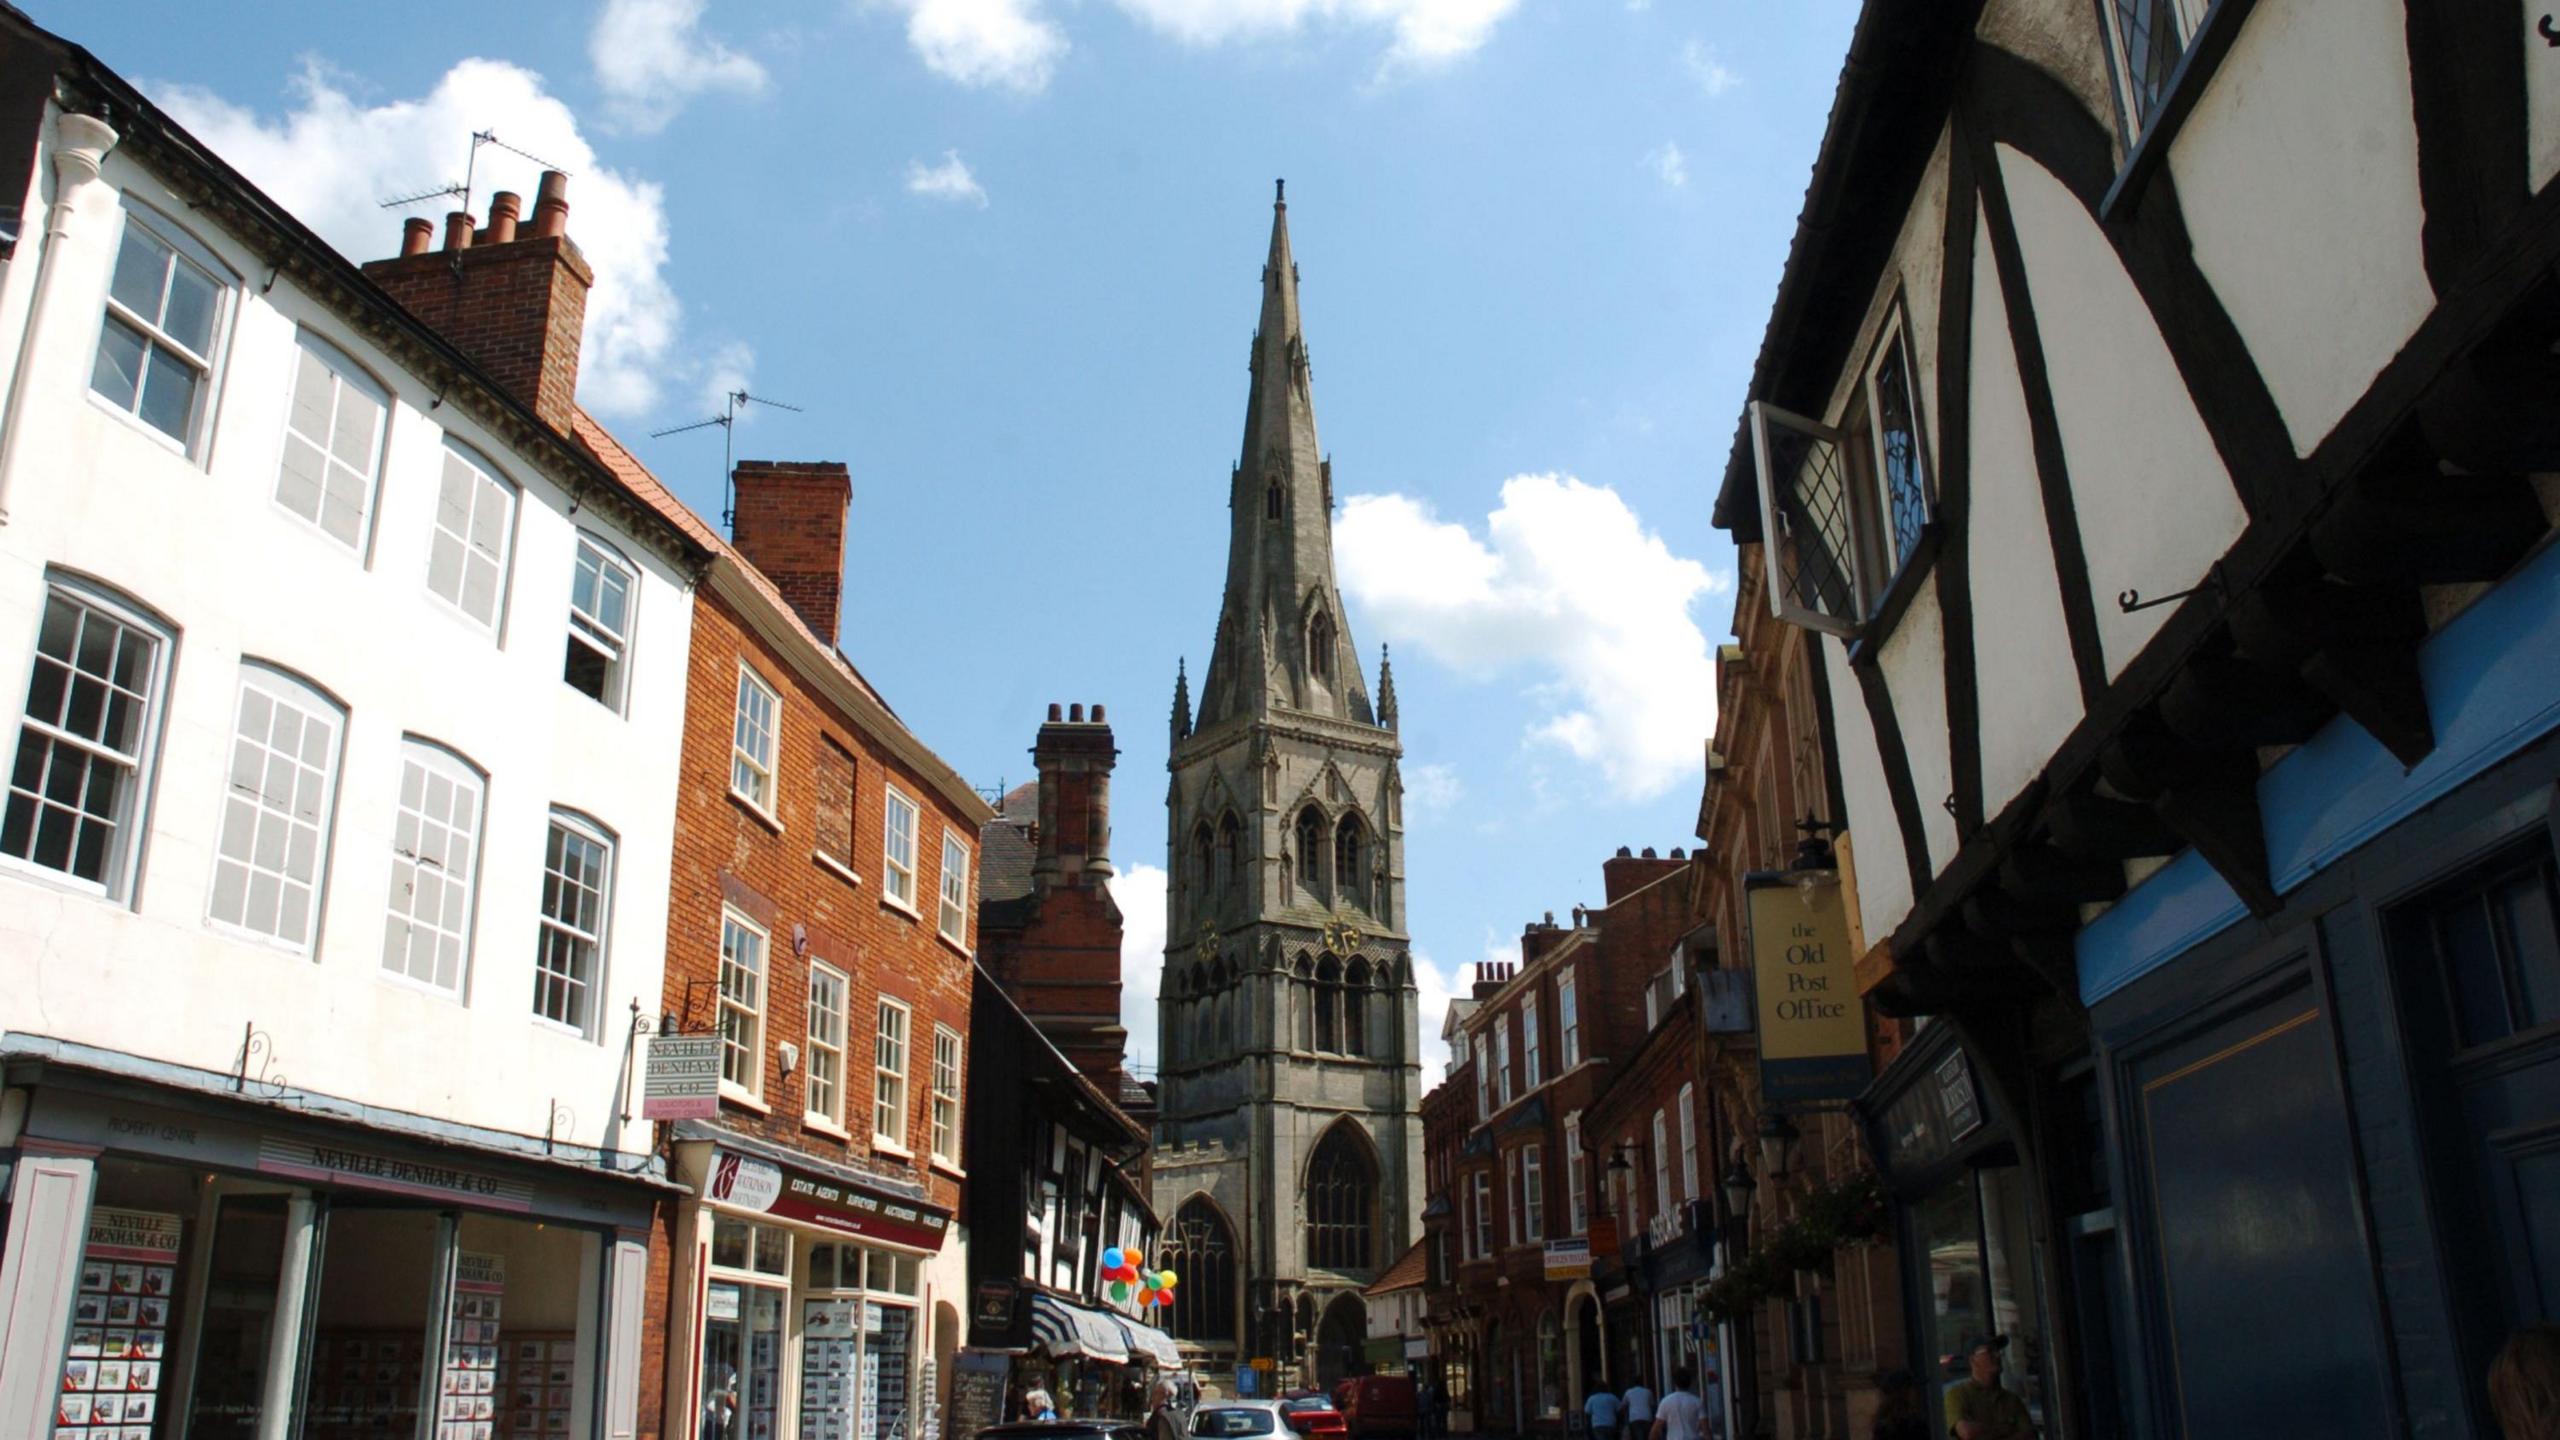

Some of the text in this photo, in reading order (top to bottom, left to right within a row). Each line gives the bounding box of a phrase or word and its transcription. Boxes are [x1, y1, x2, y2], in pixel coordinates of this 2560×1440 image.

[1791, 923, 1816, 938] the
[1786, 943, 1825, 966] Old
[1788, 972, 1829, 993] Post
[1776, 998, 1845, 1021] Office
[650, 1041, 721, 1056] NEVILLE
[648, 1060, 719, 1075] DENHAM
[679, 1082, 700, 1095] CO
[107, 1116, 198, 1145] PROPERTY CENTRE
[311, 1148, 498, 1195] NEVILLE DENHAM & CO
[791, 1179, 815, 1195] ESTATE
[815, 1186, 840, 1202] AGENTS
[107, 1214, 164, 1231] NEVILLE
[89, 1227, 177, 1249] DENHAM & CO
